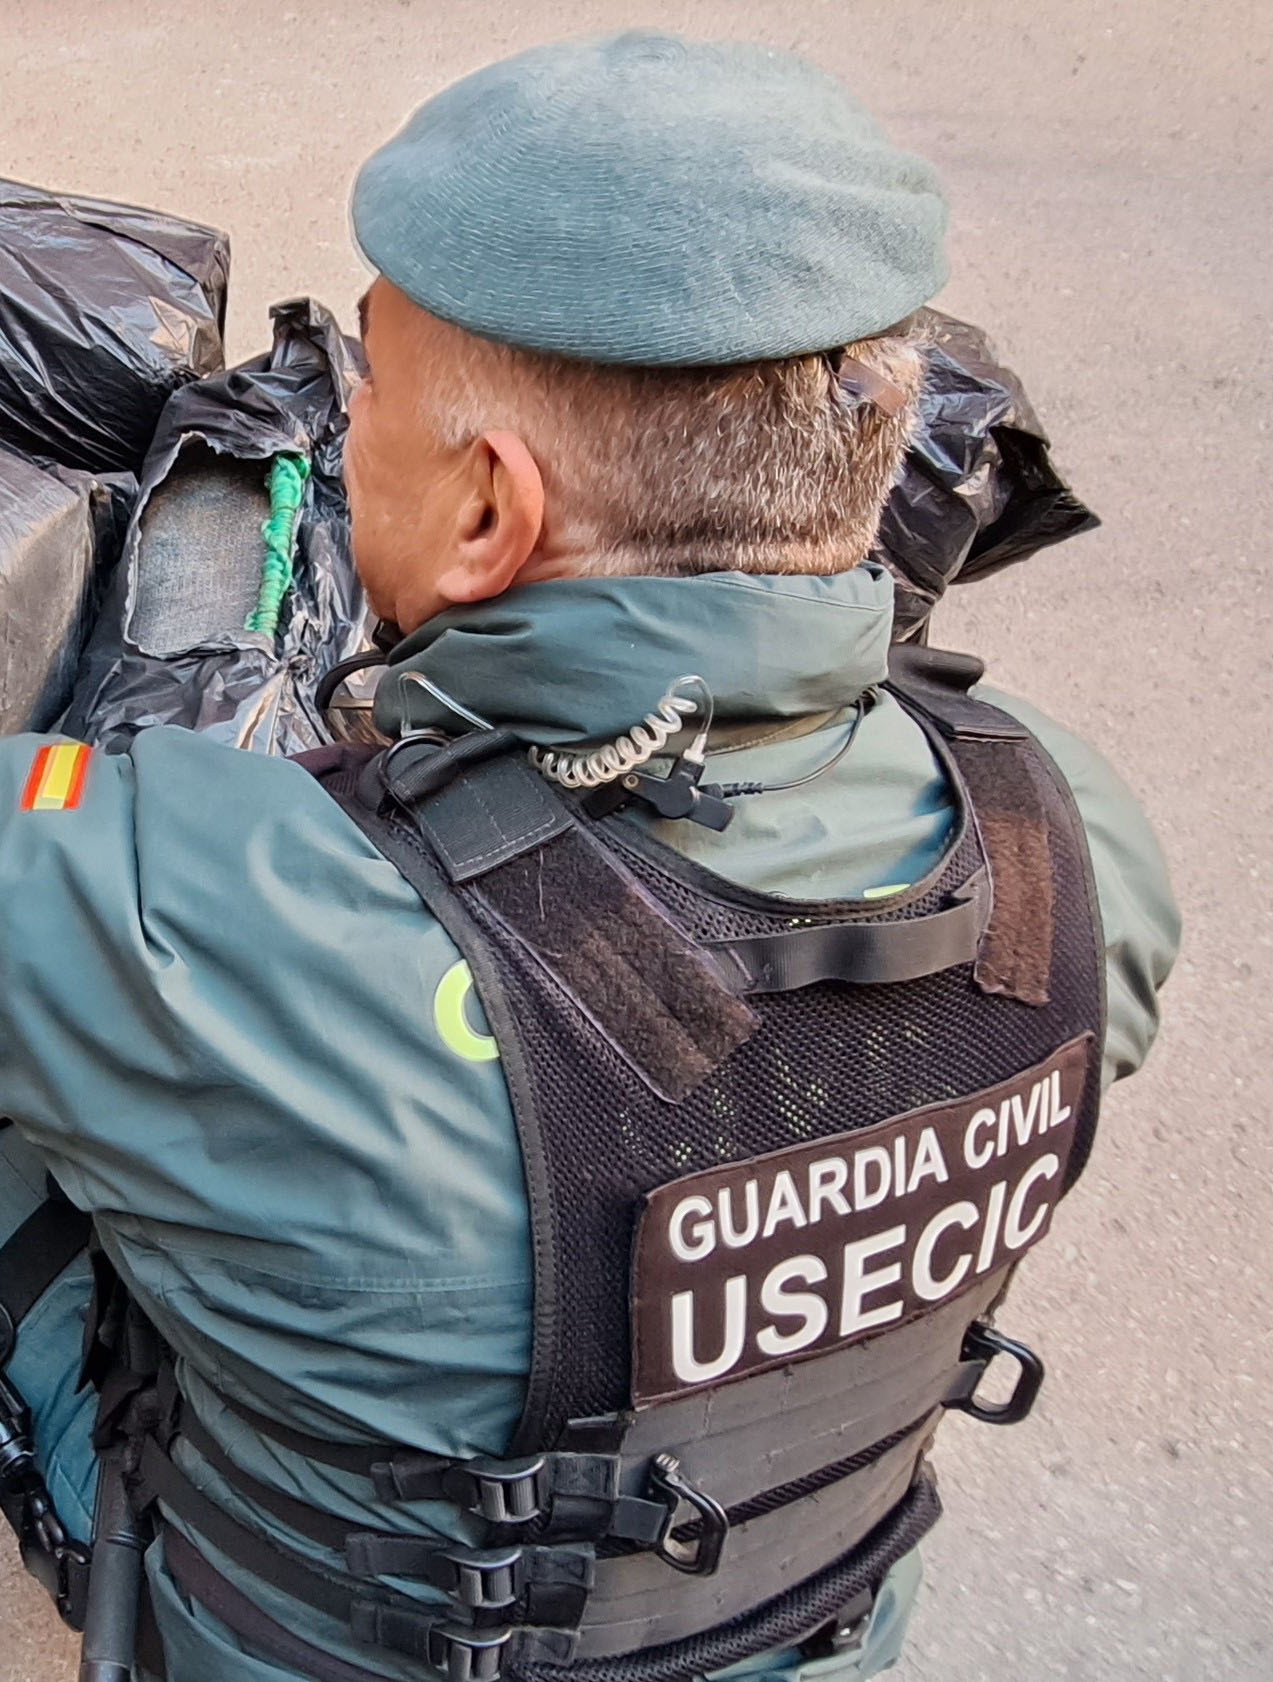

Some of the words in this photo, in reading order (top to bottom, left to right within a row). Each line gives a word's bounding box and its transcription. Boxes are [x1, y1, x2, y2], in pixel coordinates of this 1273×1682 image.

[668, 1126, 949, 1263] GUARDIA
[963, 1069, 1072, 1170] CIVIL
[670, 1153, 1059, 1384] USECIC
